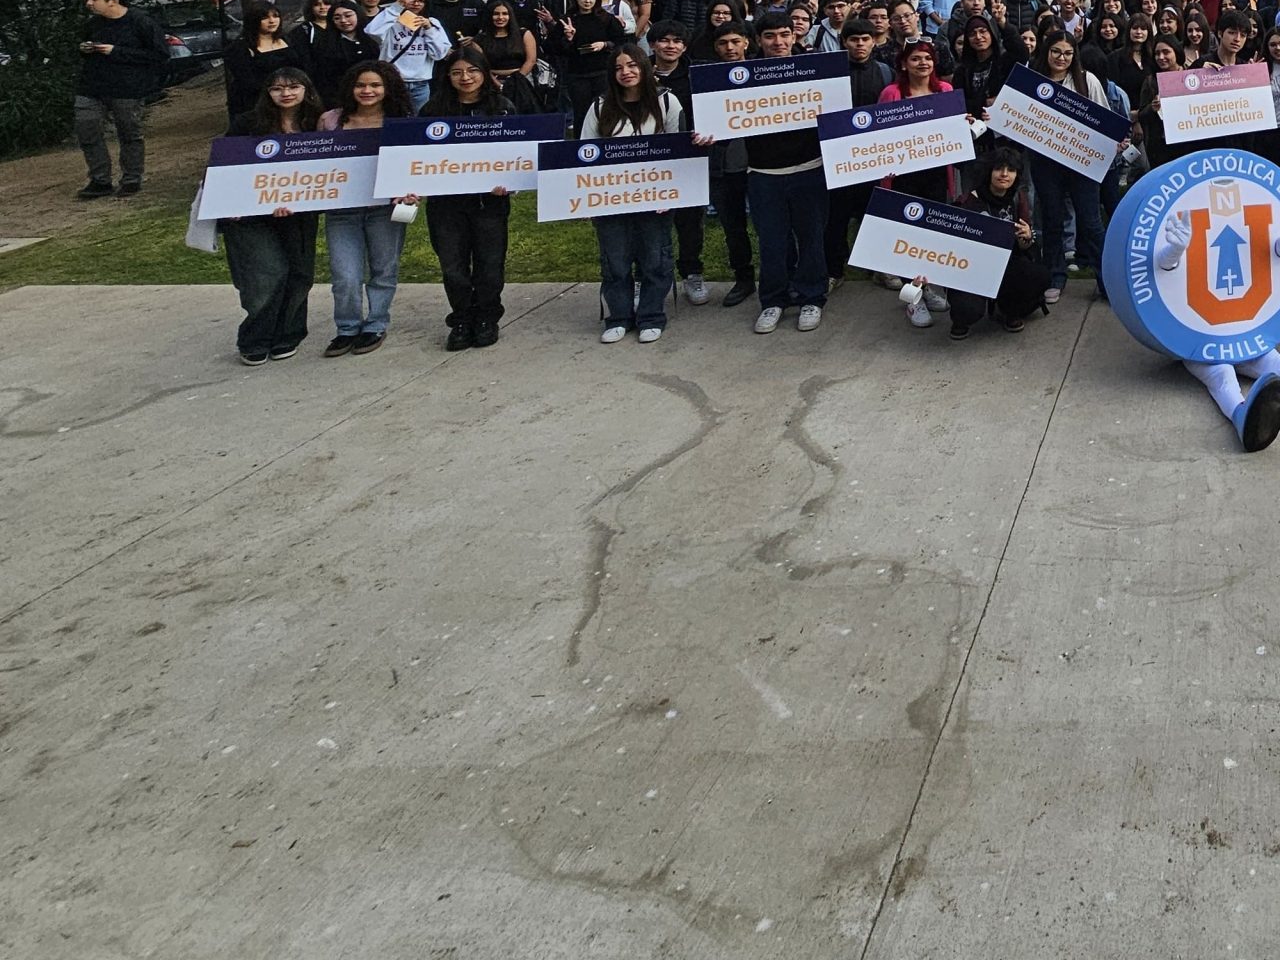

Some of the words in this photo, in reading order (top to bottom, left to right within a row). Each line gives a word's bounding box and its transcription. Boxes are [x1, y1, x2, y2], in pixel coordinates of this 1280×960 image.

[754, 63, 794, 73] Universidad
[754, 72, 782, 80] Católica
[784, 70, 794, 78] del
[796, 68, 815, 76] Norte
[726, 89, 822, 113] Ingeniería
[875, 104, 914, 116] Universidad
[1056, 92, 1088, 111] Universidad
[1189, 97, 1249, 117] Ingeniería
[728, 105, 822, 130] Comercial
[915, 108, 934, 116] Norte
[1074, 109, 1086, 118] del
[1083, 113, 1101, 125] Norte
[1178, 120, 1192, 130] en
[1196, 110, 1264, 128] Acuicultura
[928, 133, 943, 142] en
[1001, 102, 1054, 135] Prevención
[1056, 131, 1069, 141] de
[1069, 139, 1105, 161] Riesgos
[1078, 129, 1090, 140] en
[285, 138, 333, 147] Universidad
[285, 147, 317, 155] Católica
[605, 141, 648, 151] Universidad
[1004, 119, 1011, 127] y
[1012, 122, 1042, 143] Medio
[1044, 139, 1091, 167] Ambiente
[605, 151, 635, 159] Católica
[897, 153, 906, 164] y
[908, 141, 962, 160] Religión
[411, 156, 533, 175] Enfermería
[254, 169, 348, 189] Biología
[576, 168, 672, 188] Nutrición
[258, 187, 339, 204] Marina
[570, 198, 581, 213] y
[588, 187, 679, 207] Dietética
[1216, 191, 1235, 210] N
[928, 208, 967, 223] Universidad
[926, 216, 951, 228] Católica
[964, 226, 983, 236] Norte
[1130, 172, 1186, 305] UNIVERSIDAD
[1187, 153, 1275, 186] CATÓLICA
[893, 239, 969, 270] Derecho
[1177, 204, 1273, 325] U
[1202, 334, 1269, 360] CHILE
